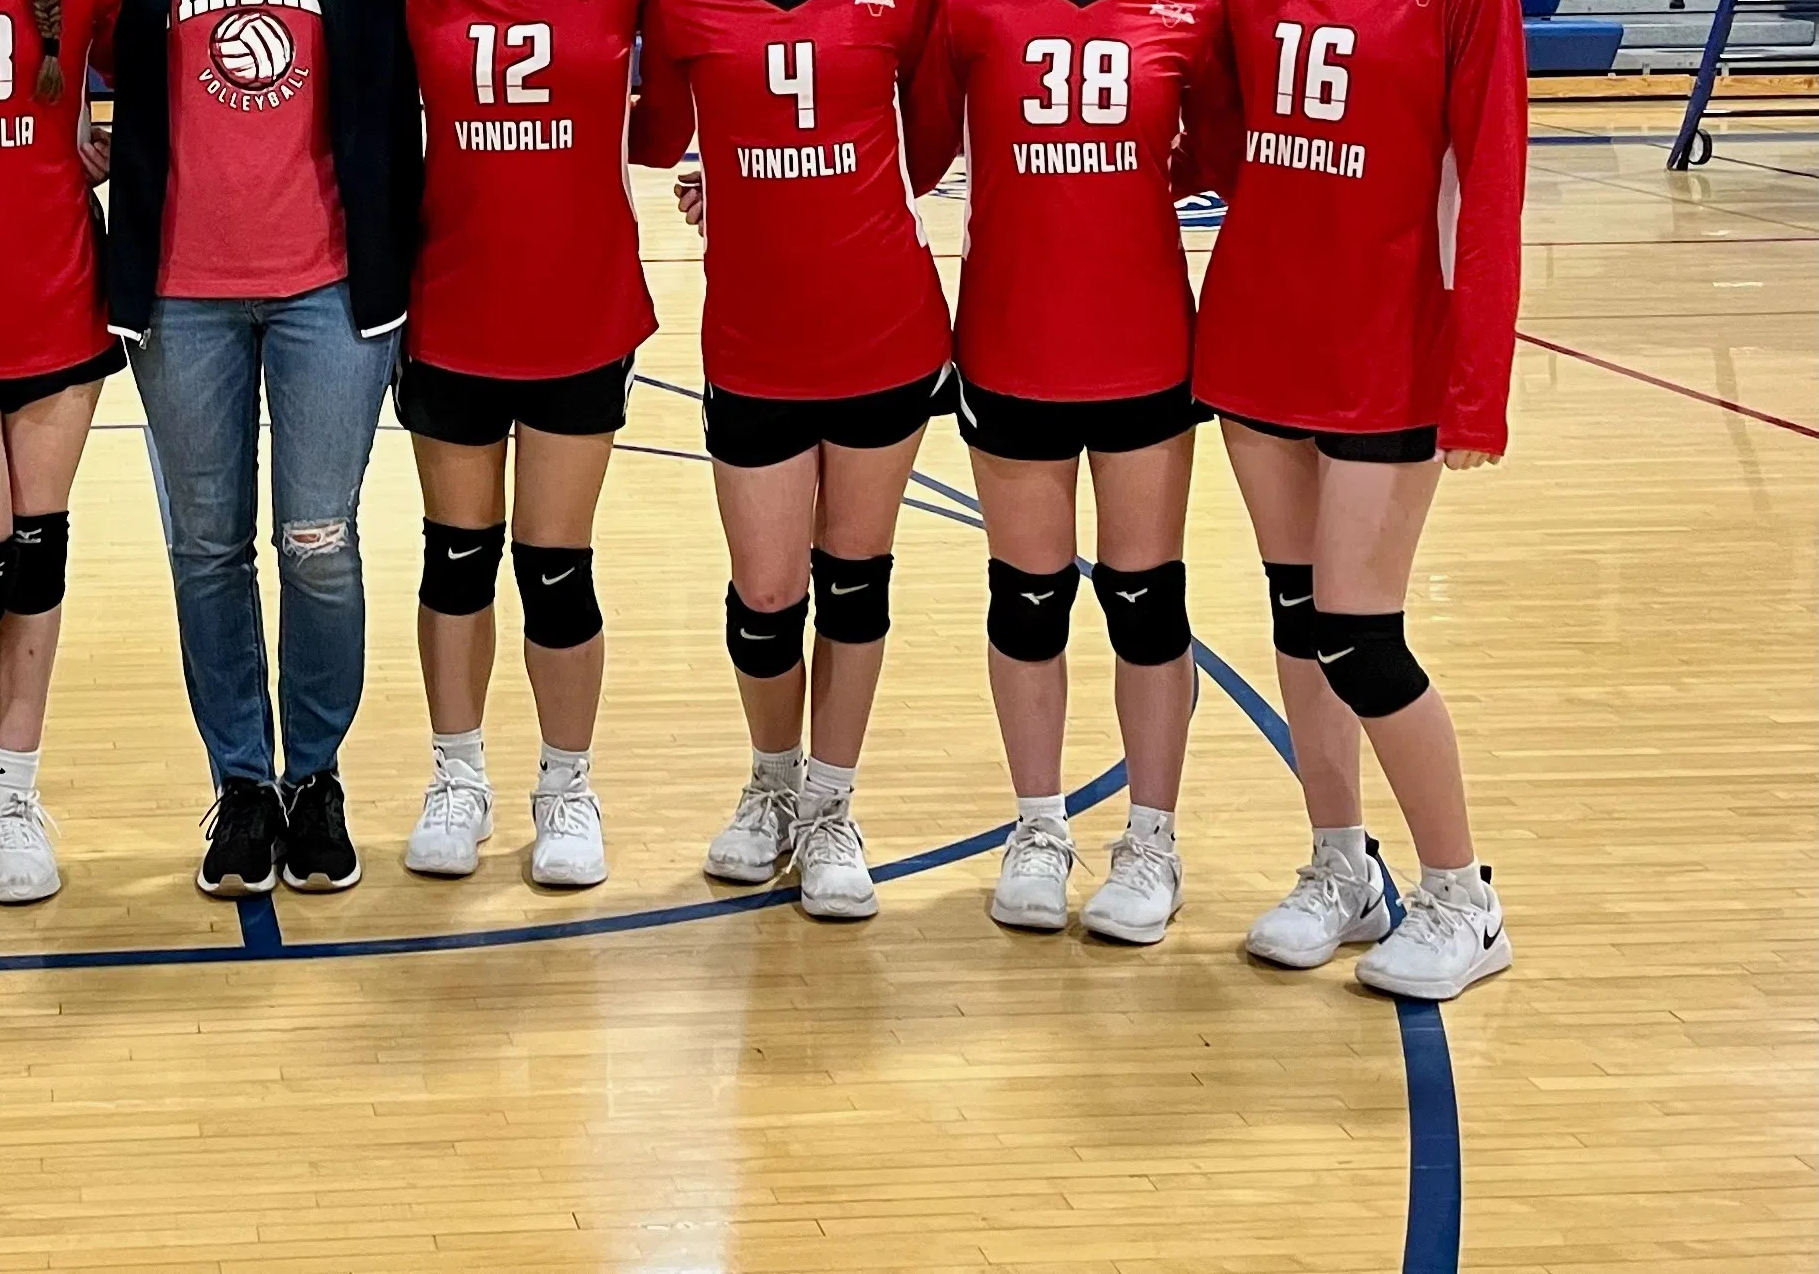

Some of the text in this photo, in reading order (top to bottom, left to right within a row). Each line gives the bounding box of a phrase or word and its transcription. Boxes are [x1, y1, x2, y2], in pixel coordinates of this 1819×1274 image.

[196, 65, 311, 112] VOLLEYBALL
[468, 22, 552, 105] 12
[767, 41, 816, 130] 4
[1022, 37, 1130, 125] 38
[1274, 21, 1356, 122] 16
[454, 118, 573, 152] VANDALIA
[736, 141, 858, 180] VANDALIA
[1012, 140, 1139, 175] VANDALIA
[1245, 129, 1366, 180] VANDALIA
